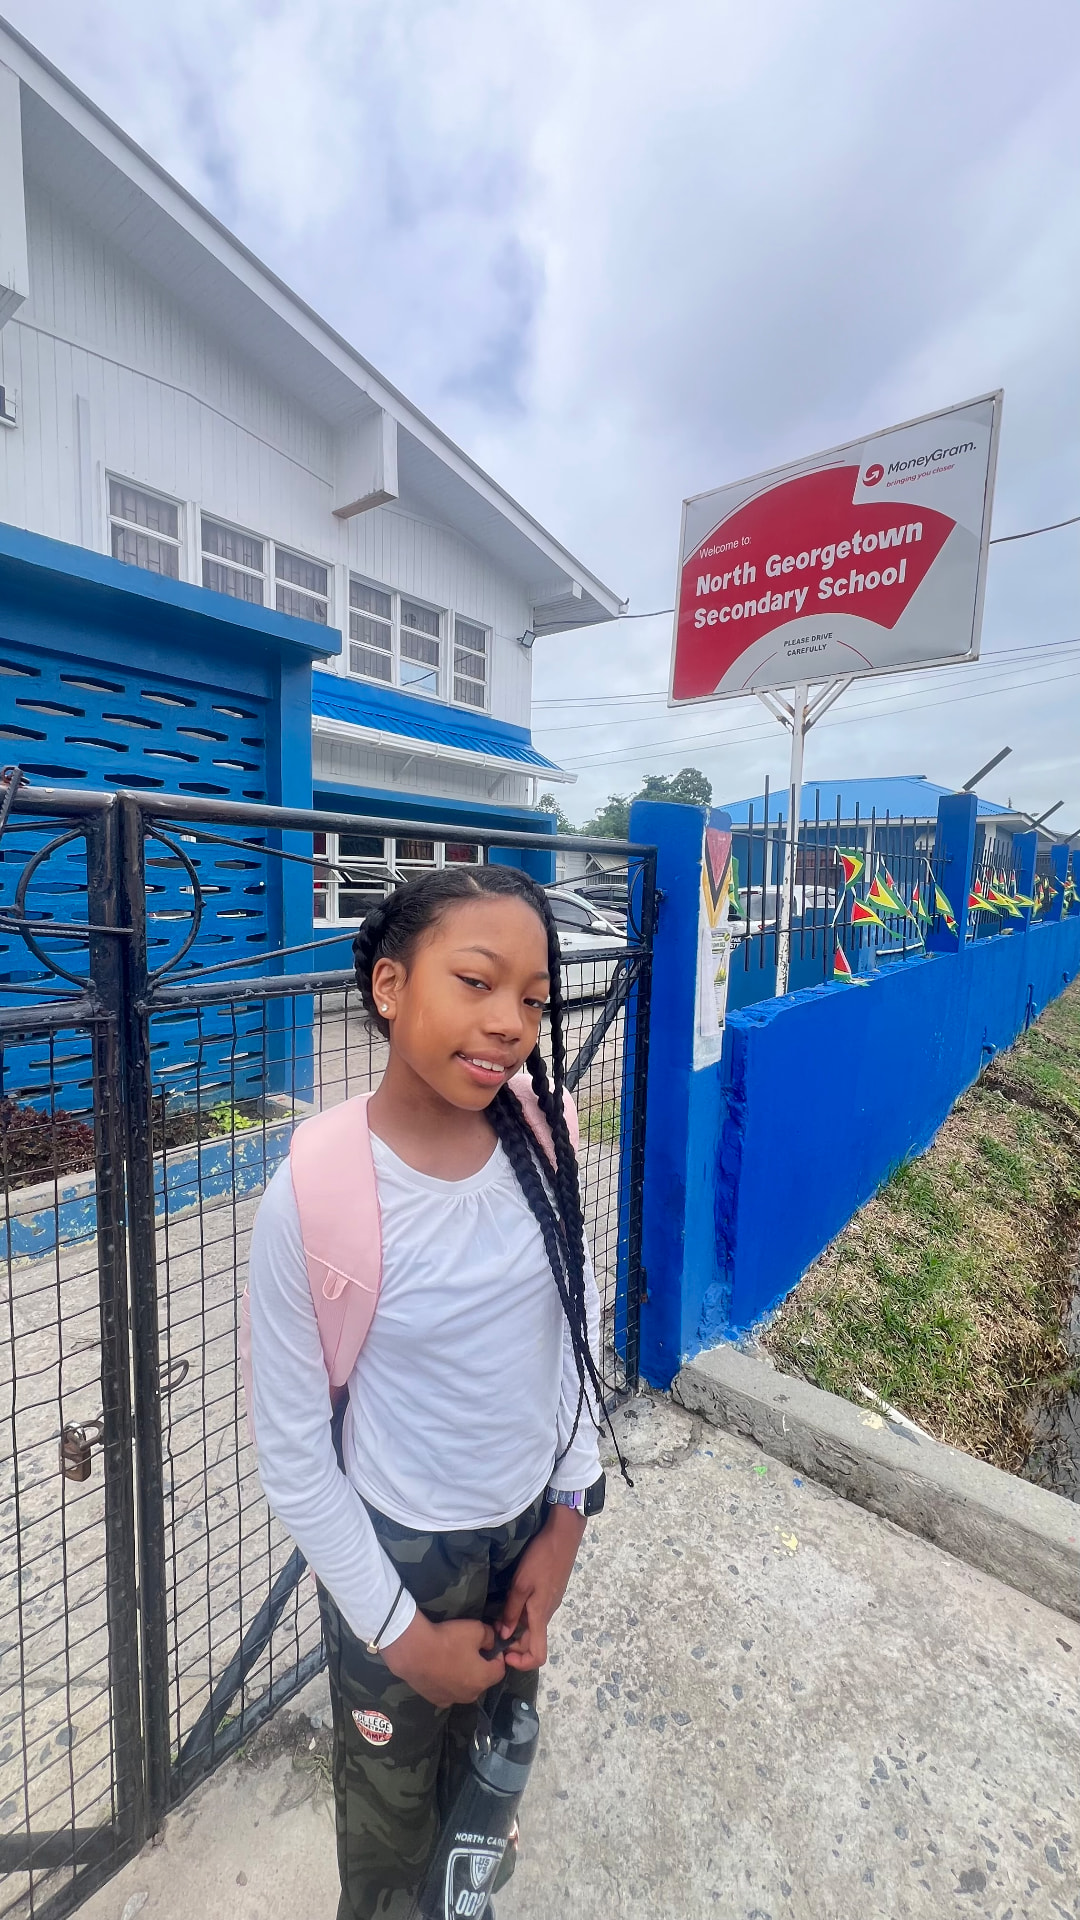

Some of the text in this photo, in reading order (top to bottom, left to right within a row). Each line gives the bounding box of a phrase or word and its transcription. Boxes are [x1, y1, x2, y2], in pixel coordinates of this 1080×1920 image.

[888, 441, 977, 475] MoneyGram.
[886, 463, 956, 488] bringing you closer
[696, 521, 923, 597] North Georgetown
[700, 539, 739, 559] Welcome
[694, 558, 907, 629] Secondary School
[783, 632, 833, 647] PLEASE DRIVE
[787, 643, 828, 657] CAREFULLY
[455, 1832, 485, 1844] NORTH
[479, 1857, 490, 1867] US
